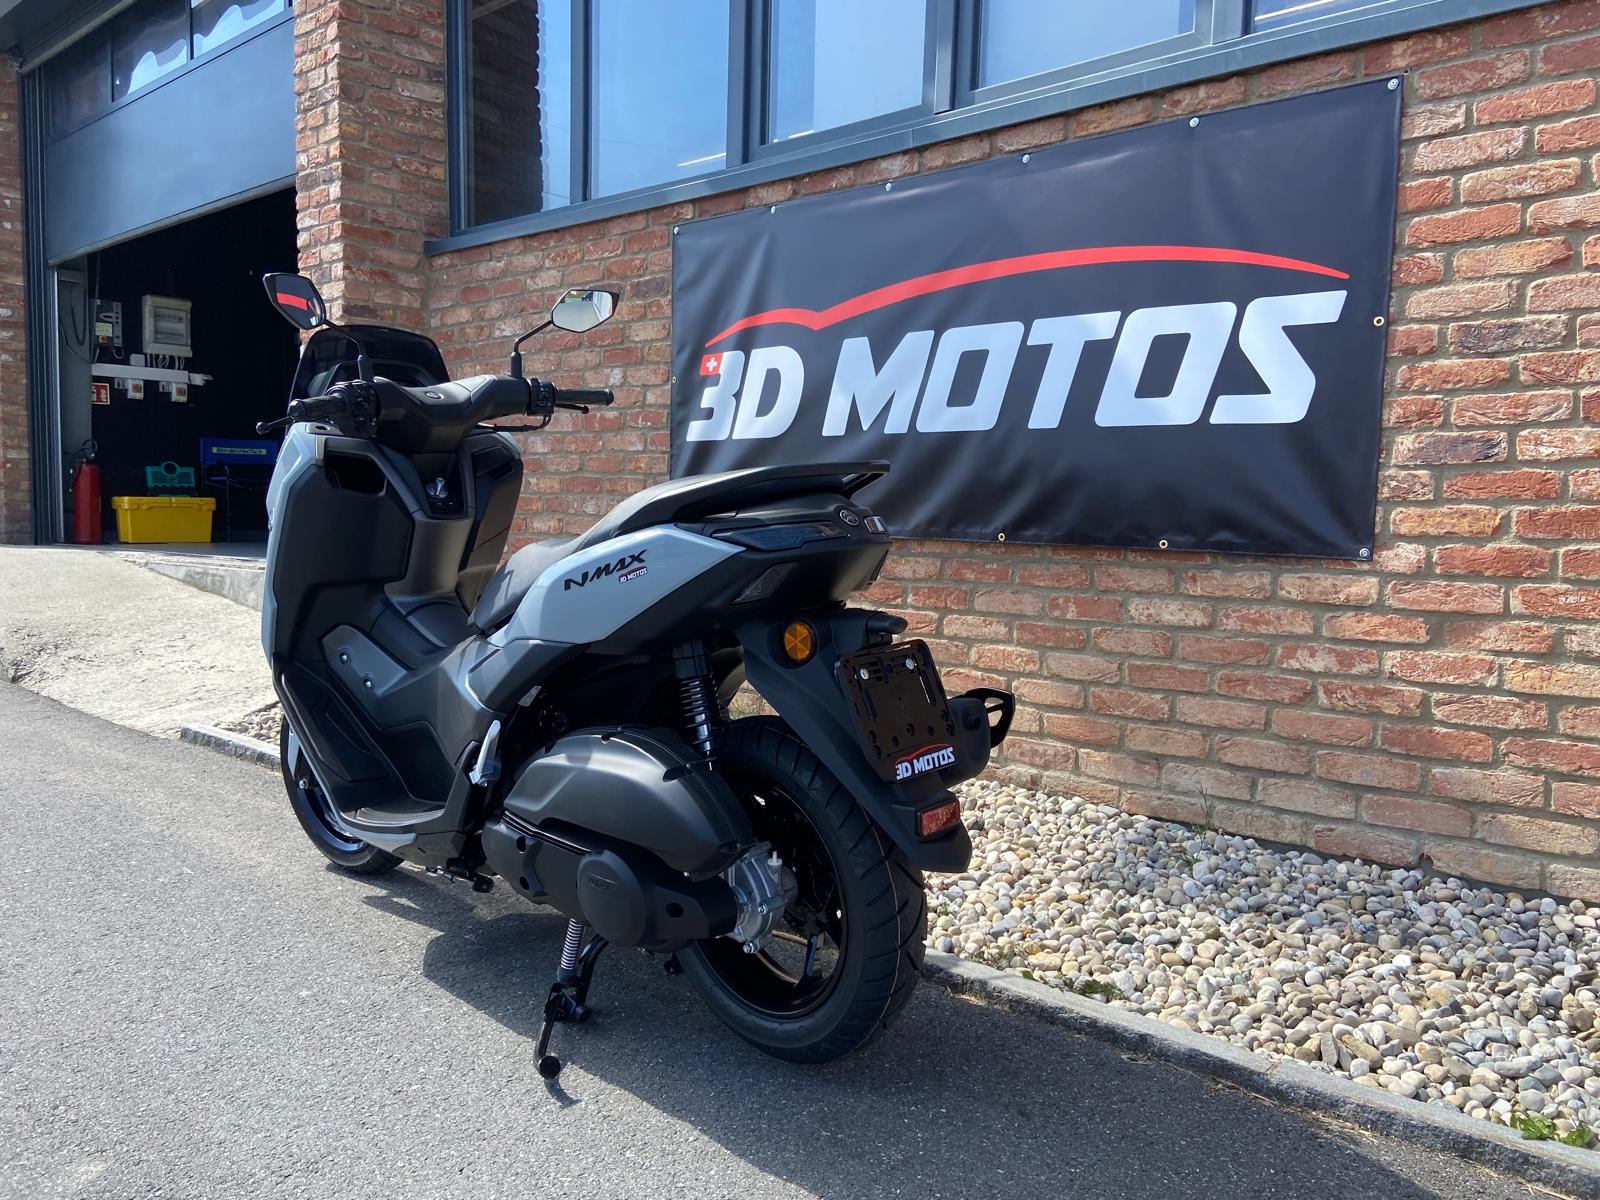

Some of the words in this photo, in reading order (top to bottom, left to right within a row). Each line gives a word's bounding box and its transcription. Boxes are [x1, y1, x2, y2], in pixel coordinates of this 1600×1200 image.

[686, 346, 804, 441] 3D
[822, 290, 1347, 436] MOTOS
[564, 549, 648, 591] NMAX
[627, 568, 647, 580] MOTOS
[896, 761, 912, 780] 3D
[913, 747, 955, 774] MOTOS
